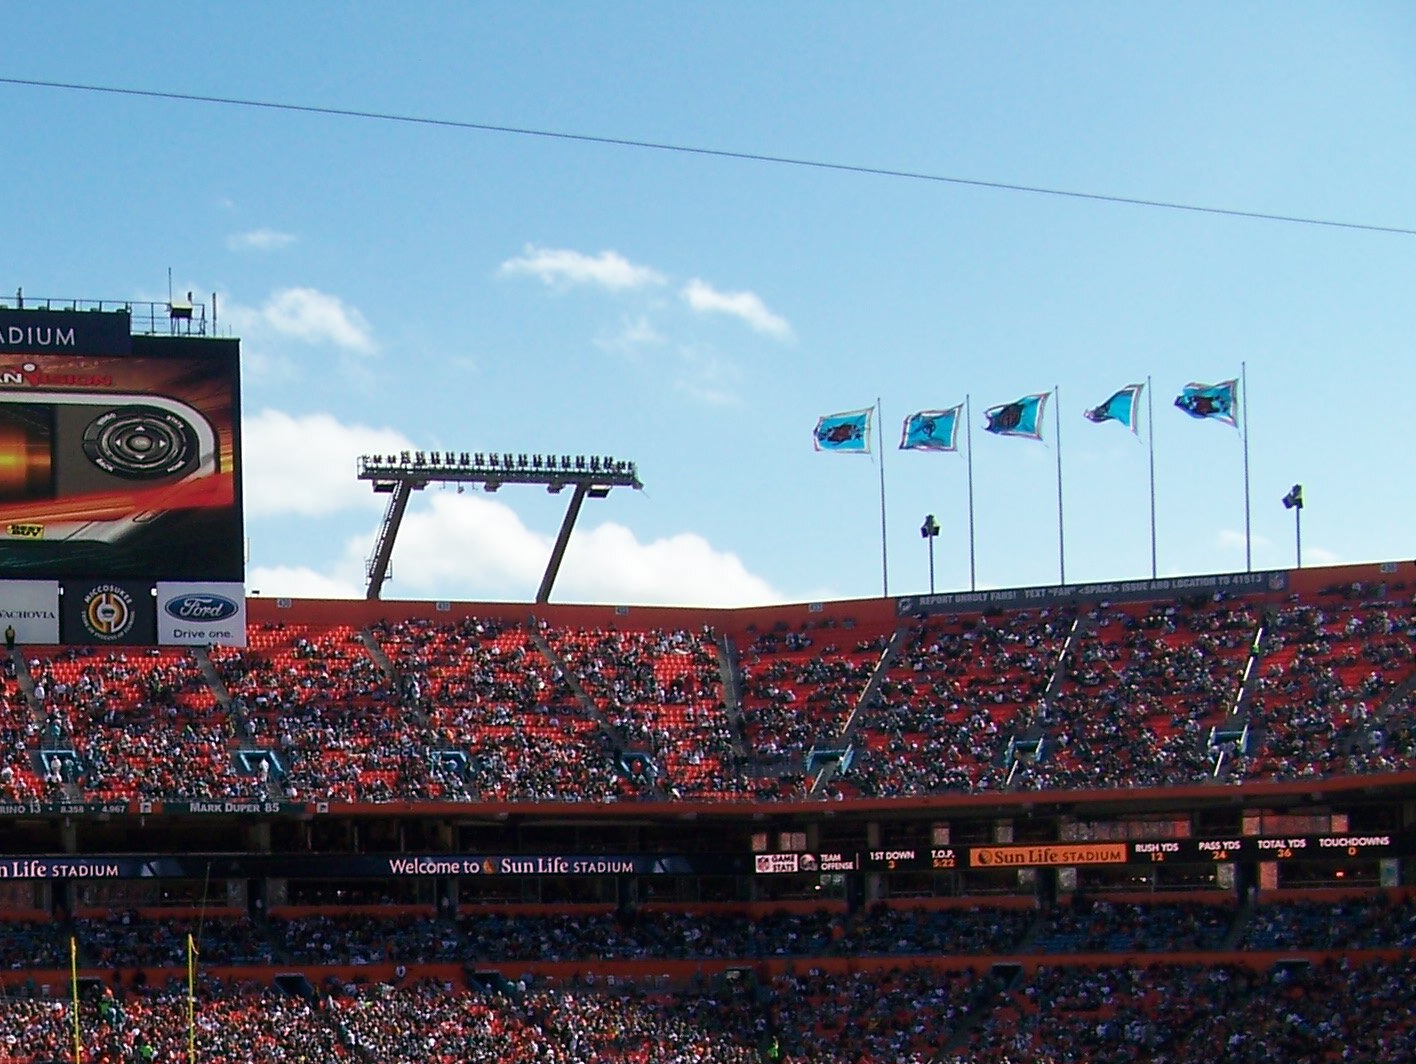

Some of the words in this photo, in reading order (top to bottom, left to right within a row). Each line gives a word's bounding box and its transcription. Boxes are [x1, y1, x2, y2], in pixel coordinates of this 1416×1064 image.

[179, 597, 224, 618] Ford
[173, 628, 206, 640] Drive
[208, 631, 235, 640] one.
[30, 802, 42, 815] 13
[189, 802, 222, 813] MARK
[225, 802, 260, 813] DUPER
[264, 802, 280, 813] 85
[1135, 843, 1159, 853] RUSH
[1161, 842, 1179, 852] YDS
[1198, 841, 1221, 850] PASS
[1222, 840, 1241, 850] YDS
[1257, 839, 1286, 849] TOTAL
[1287, 838, 1306, 848] YDS
[1319, 836, 1390, 848] TOUCHDOWNS
[820, 853, 842, 862] TEAM
[870, 851, 884, 861] 1ST
[886, 850, 915, 860] DOWN
[994, 850, 1024, 864] Sun
[1028, 848, 1058, 863] Life
[1062, 850, 1121, 862] STADIUM
[1150, 852, 1164, 861] 12
[1212, 850, 1227, 860] 24
[12, 860, 47, 878] Life
[51, 864, 119, 877] STADIUM
[389, 858, 460, 874] Welcome
[463, 860, 480, 874] to
[501, 858, 533, 873] Sun
[537, 856, 569, 873] Life
[573, 861, 633, 873] STADIUM
[820, 861, 854, 870] OFFENSE
